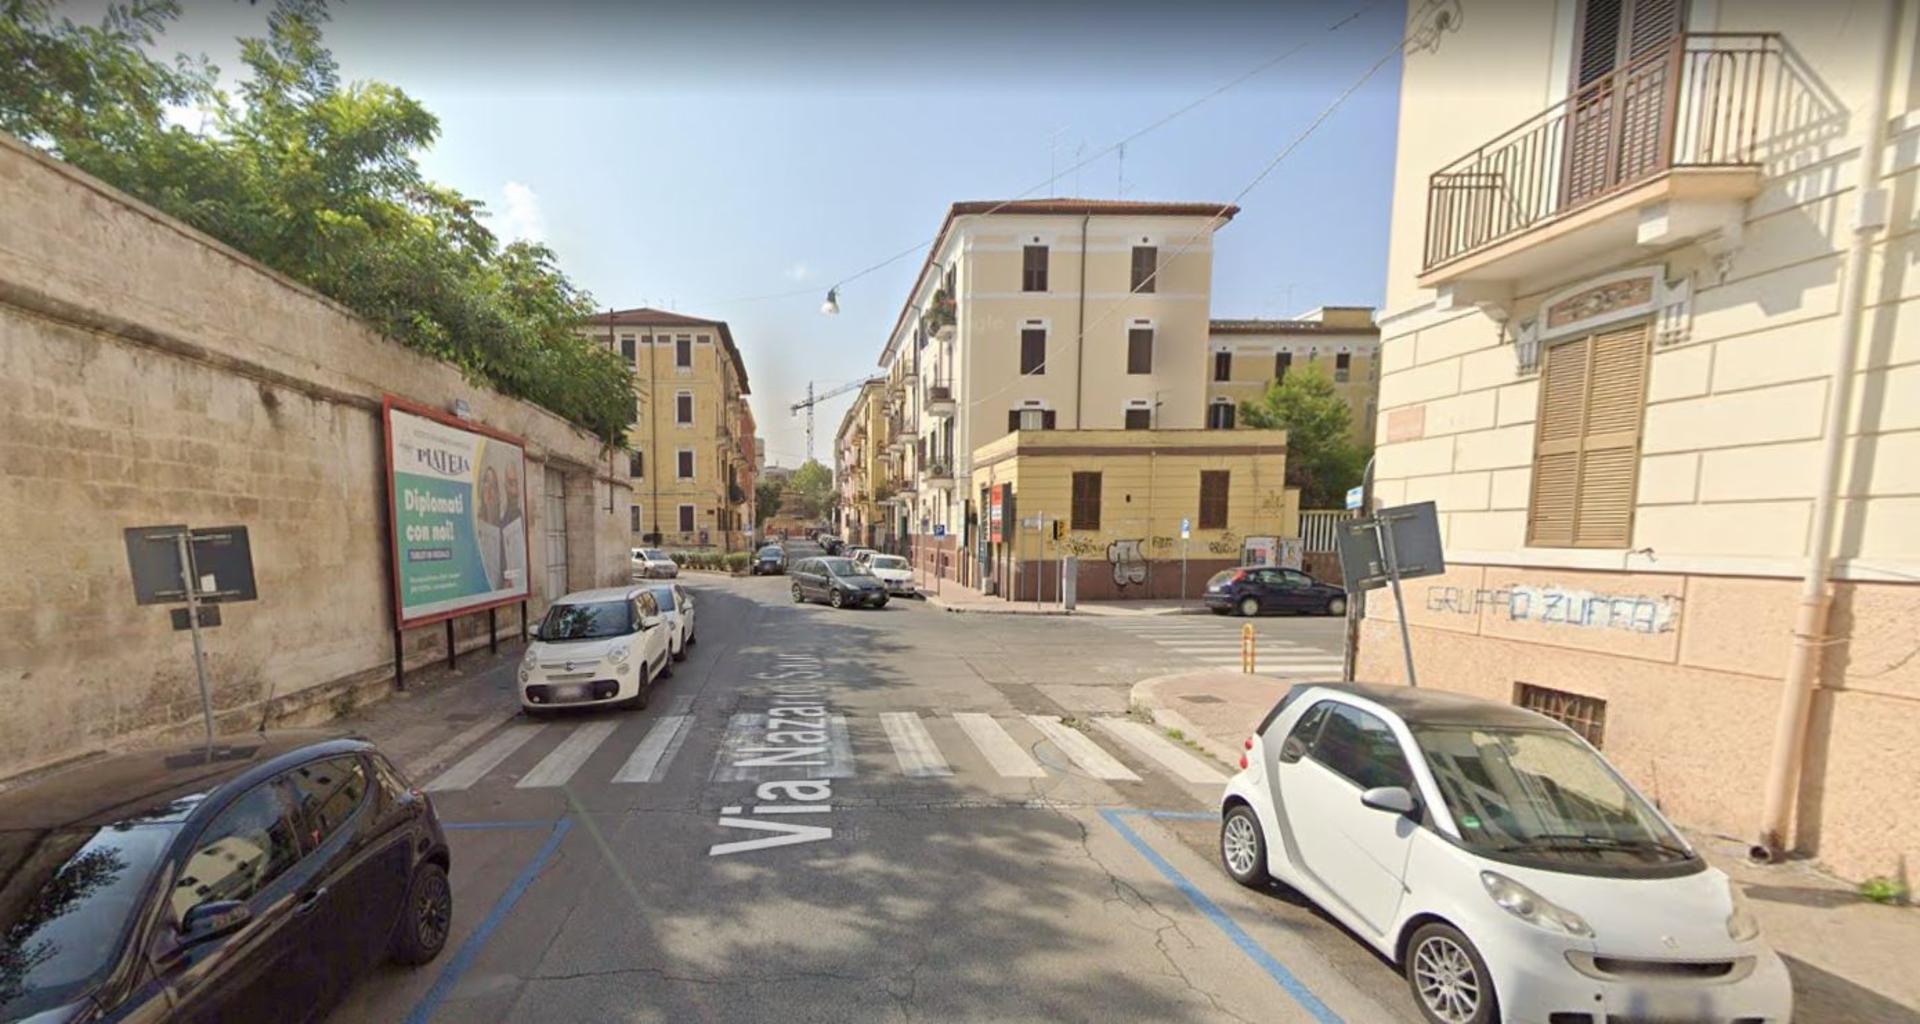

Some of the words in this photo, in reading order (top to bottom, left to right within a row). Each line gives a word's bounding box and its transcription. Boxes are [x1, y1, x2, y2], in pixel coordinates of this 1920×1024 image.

[404, 489, 464, 518] Diplomati
[406, 524, 430, 542] con
[432, 520, 455, 542] noi!
